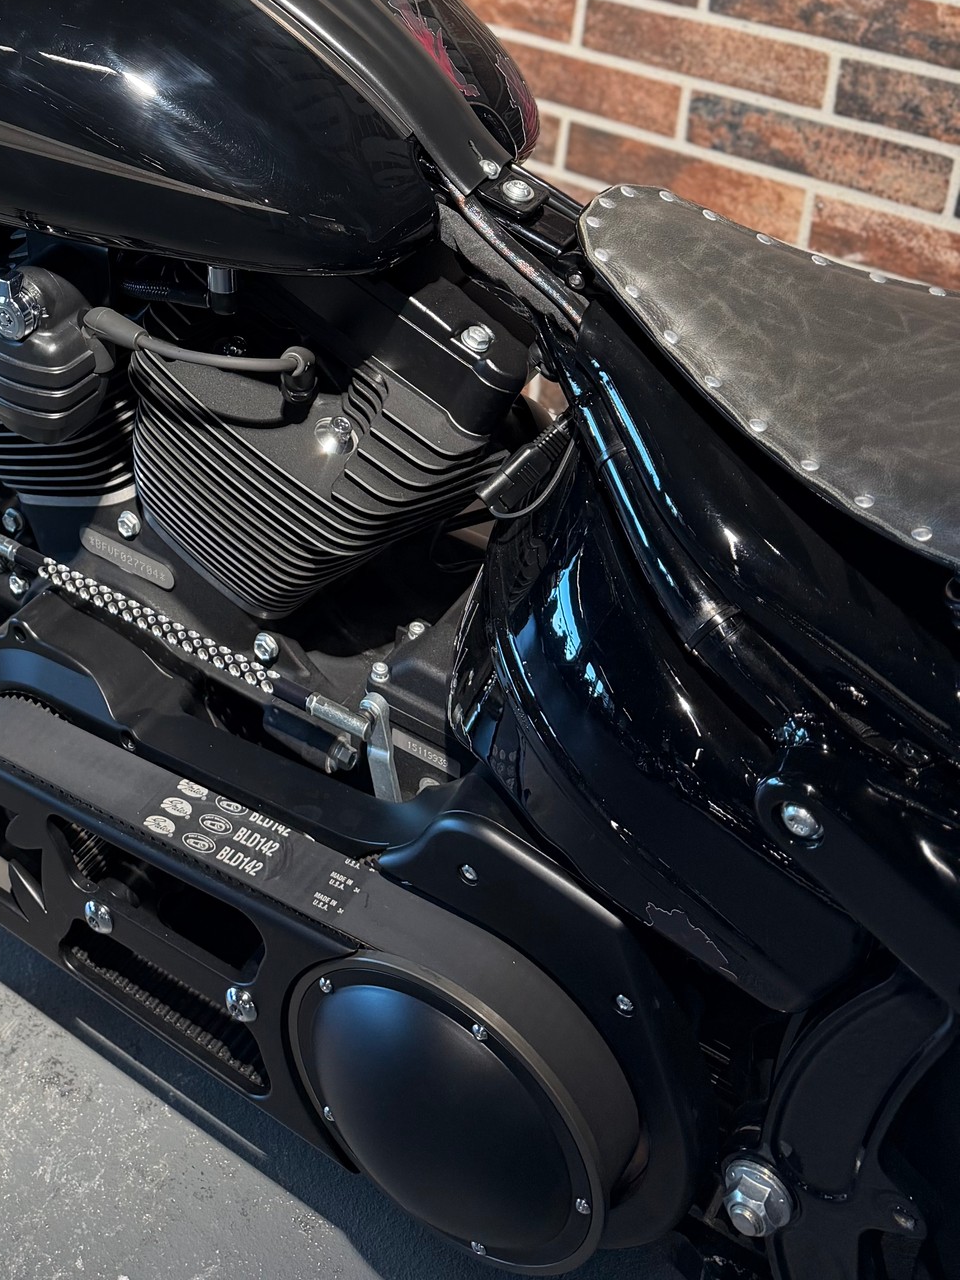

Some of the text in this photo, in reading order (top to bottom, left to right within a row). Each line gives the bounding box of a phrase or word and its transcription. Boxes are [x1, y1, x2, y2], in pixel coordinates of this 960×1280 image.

[232, 826, 280, 858] BLD142
[215, 845, 264, 877] BLD142
[330, 871, 354, 886] MADE IN
[314, 891, 338, 907] MADE IN
